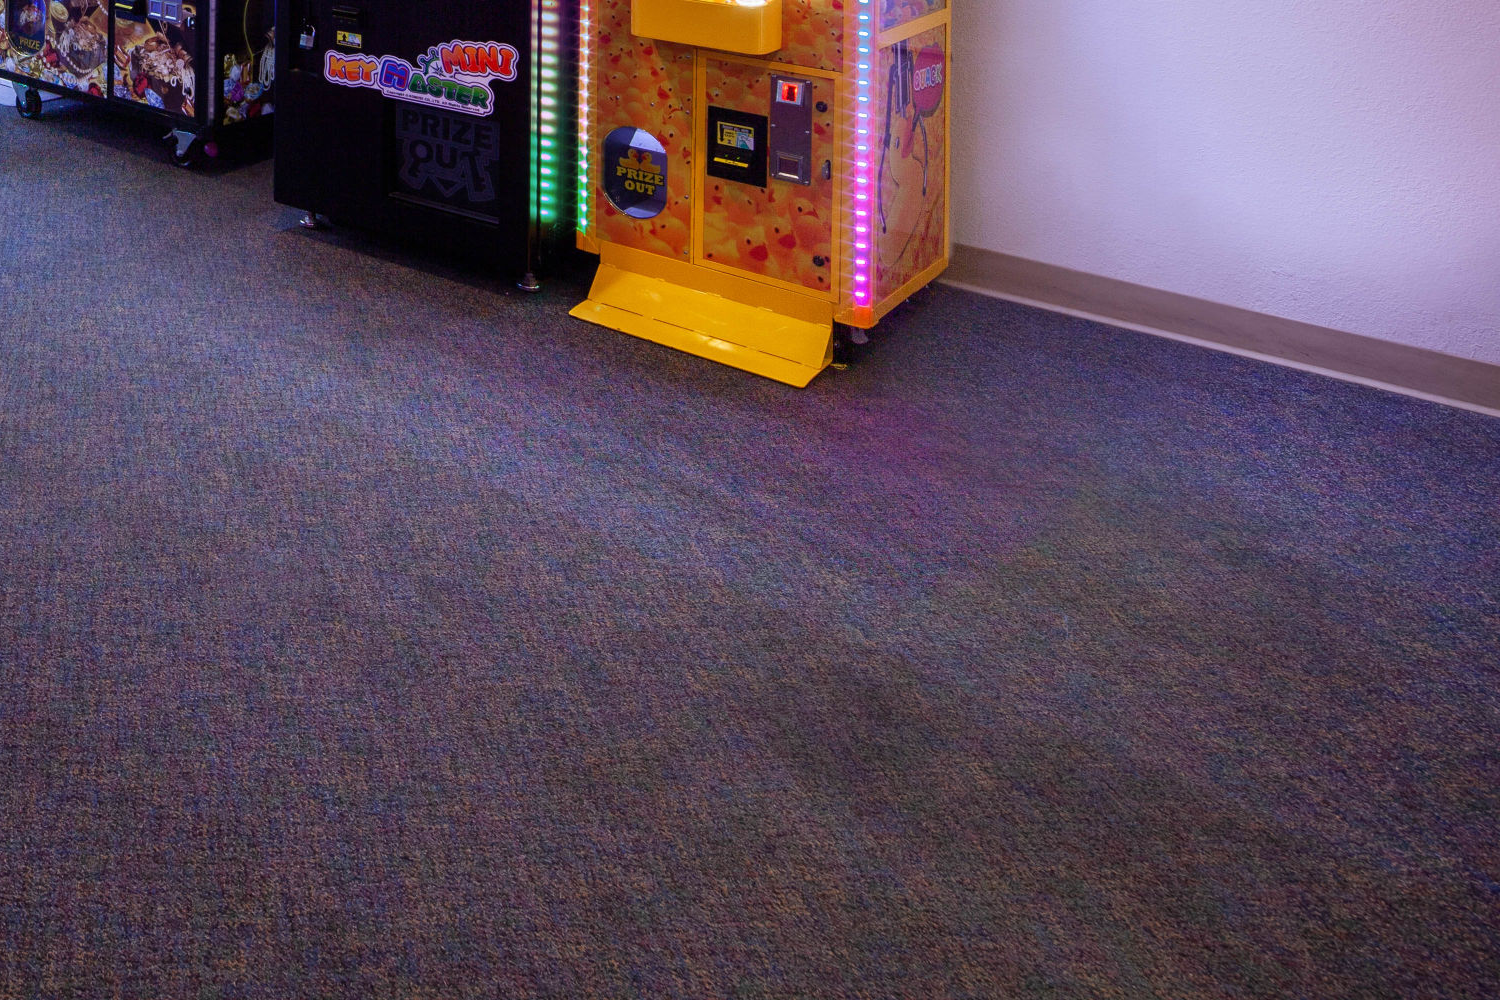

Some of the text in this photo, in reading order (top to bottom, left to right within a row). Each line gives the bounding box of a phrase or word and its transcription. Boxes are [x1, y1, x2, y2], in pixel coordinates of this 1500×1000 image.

[328, 55, 378, 82] KEY
[439, 43, 515, 76] MINI
[913, 62, 943, 91] QUACK
[402, 108, 493, 150] PRIZE
[616, 166, 665, 186] PRIZE
[624, 179, 656, 195] OUT
